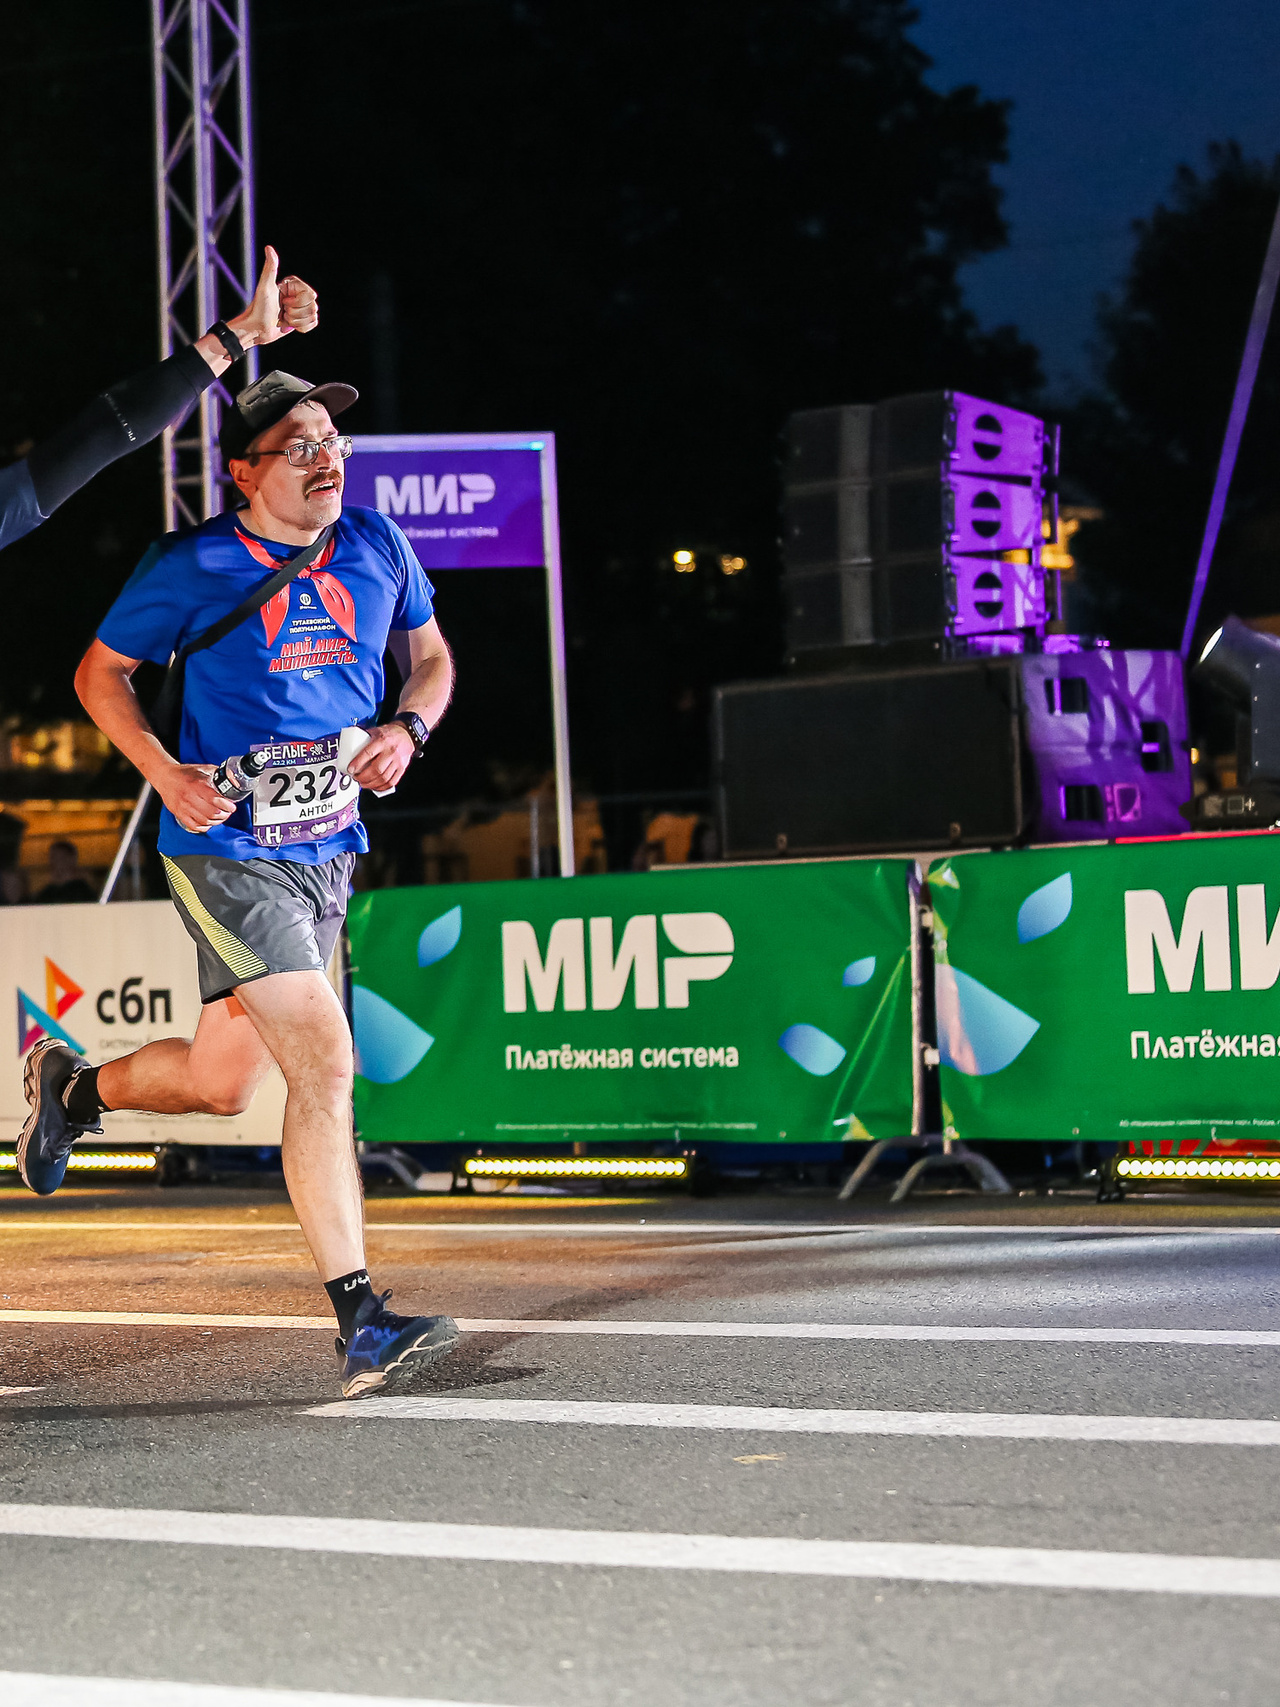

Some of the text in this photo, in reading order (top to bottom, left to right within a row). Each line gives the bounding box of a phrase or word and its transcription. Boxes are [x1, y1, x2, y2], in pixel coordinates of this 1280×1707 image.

[375, 473, 496, 515] МИР
[263, 744, 308, 760] БЕЛЫЕ
[299, 802, 333, 818] АНТОН
[501, 911, 735, 1013] МИР
[96, 976, 172, 1025] сбп
[505, 1044, 739, 1070] Платёжная система
[1130, 1028, 1280, 1059] Платёжна
